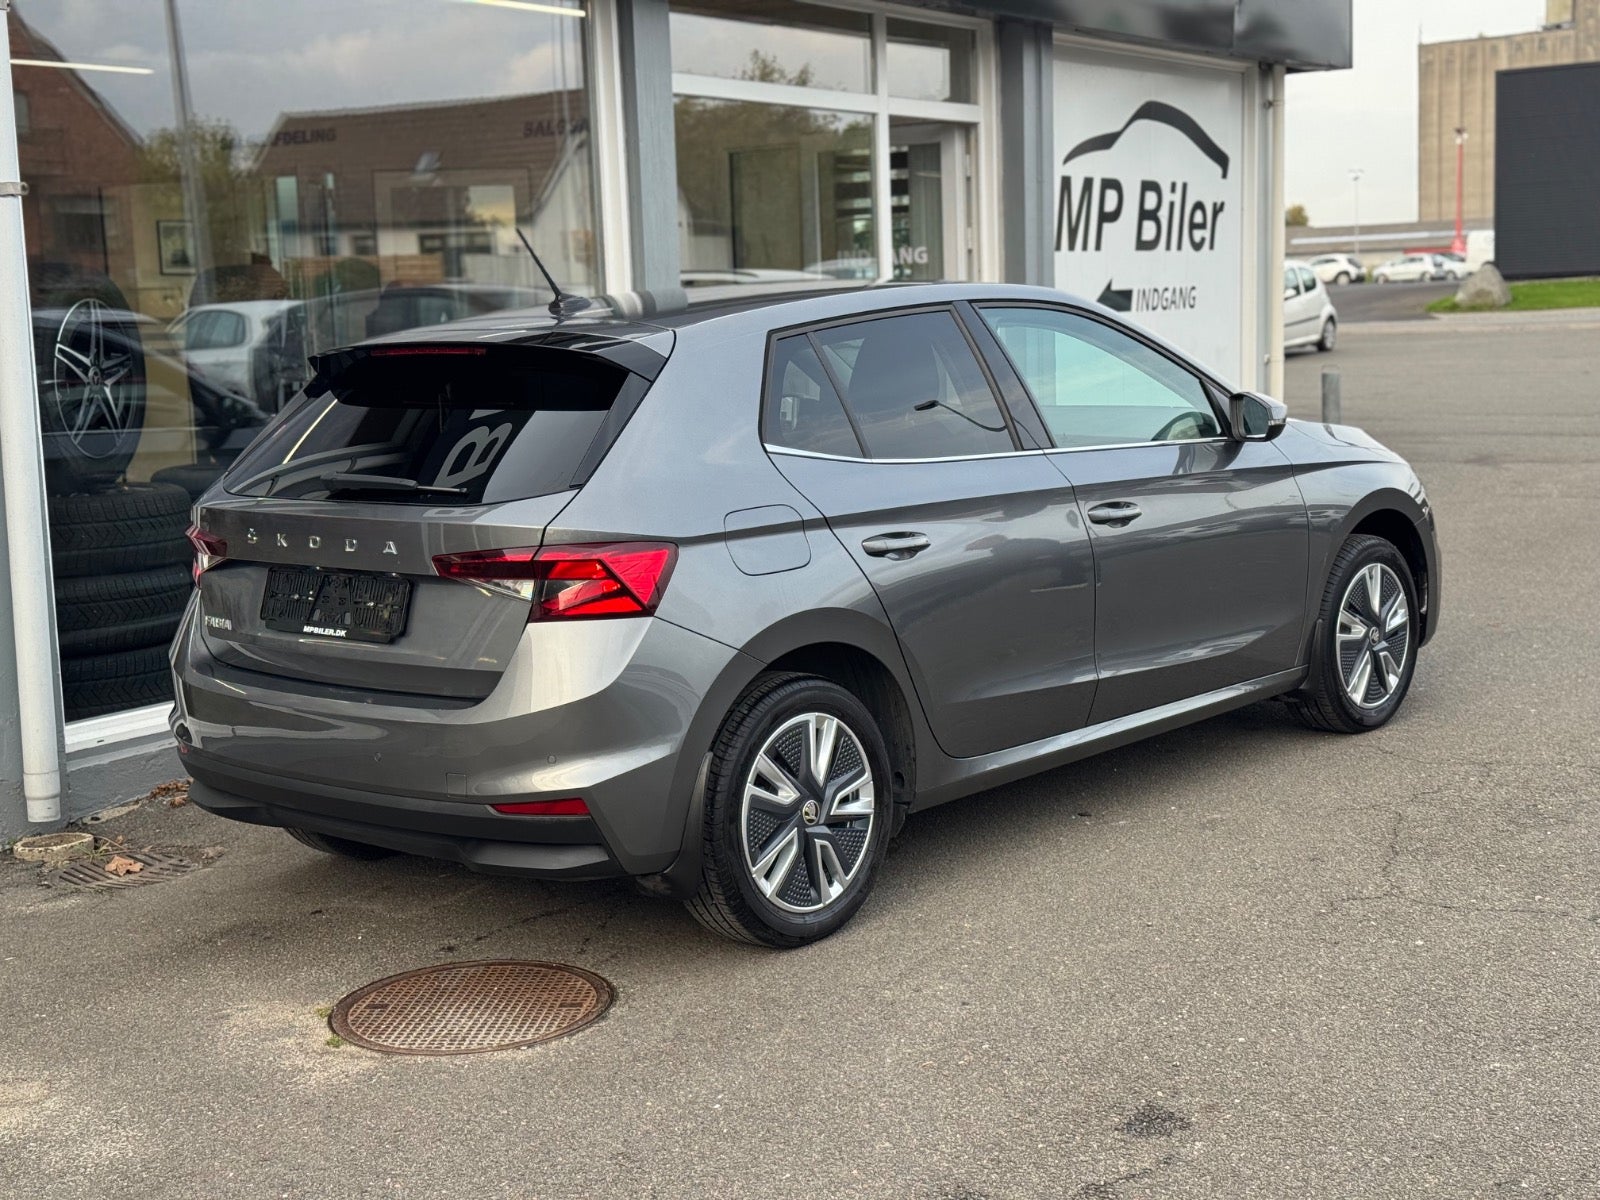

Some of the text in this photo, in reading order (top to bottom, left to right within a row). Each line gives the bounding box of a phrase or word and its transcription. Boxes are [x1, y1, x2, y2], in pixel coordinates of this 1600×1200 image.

[1055, 175, 1226, 252] MP Biler
[1136, 286, 1197, 313] INDGANG
[302, 625, 347, 637] MPBILER.DK
